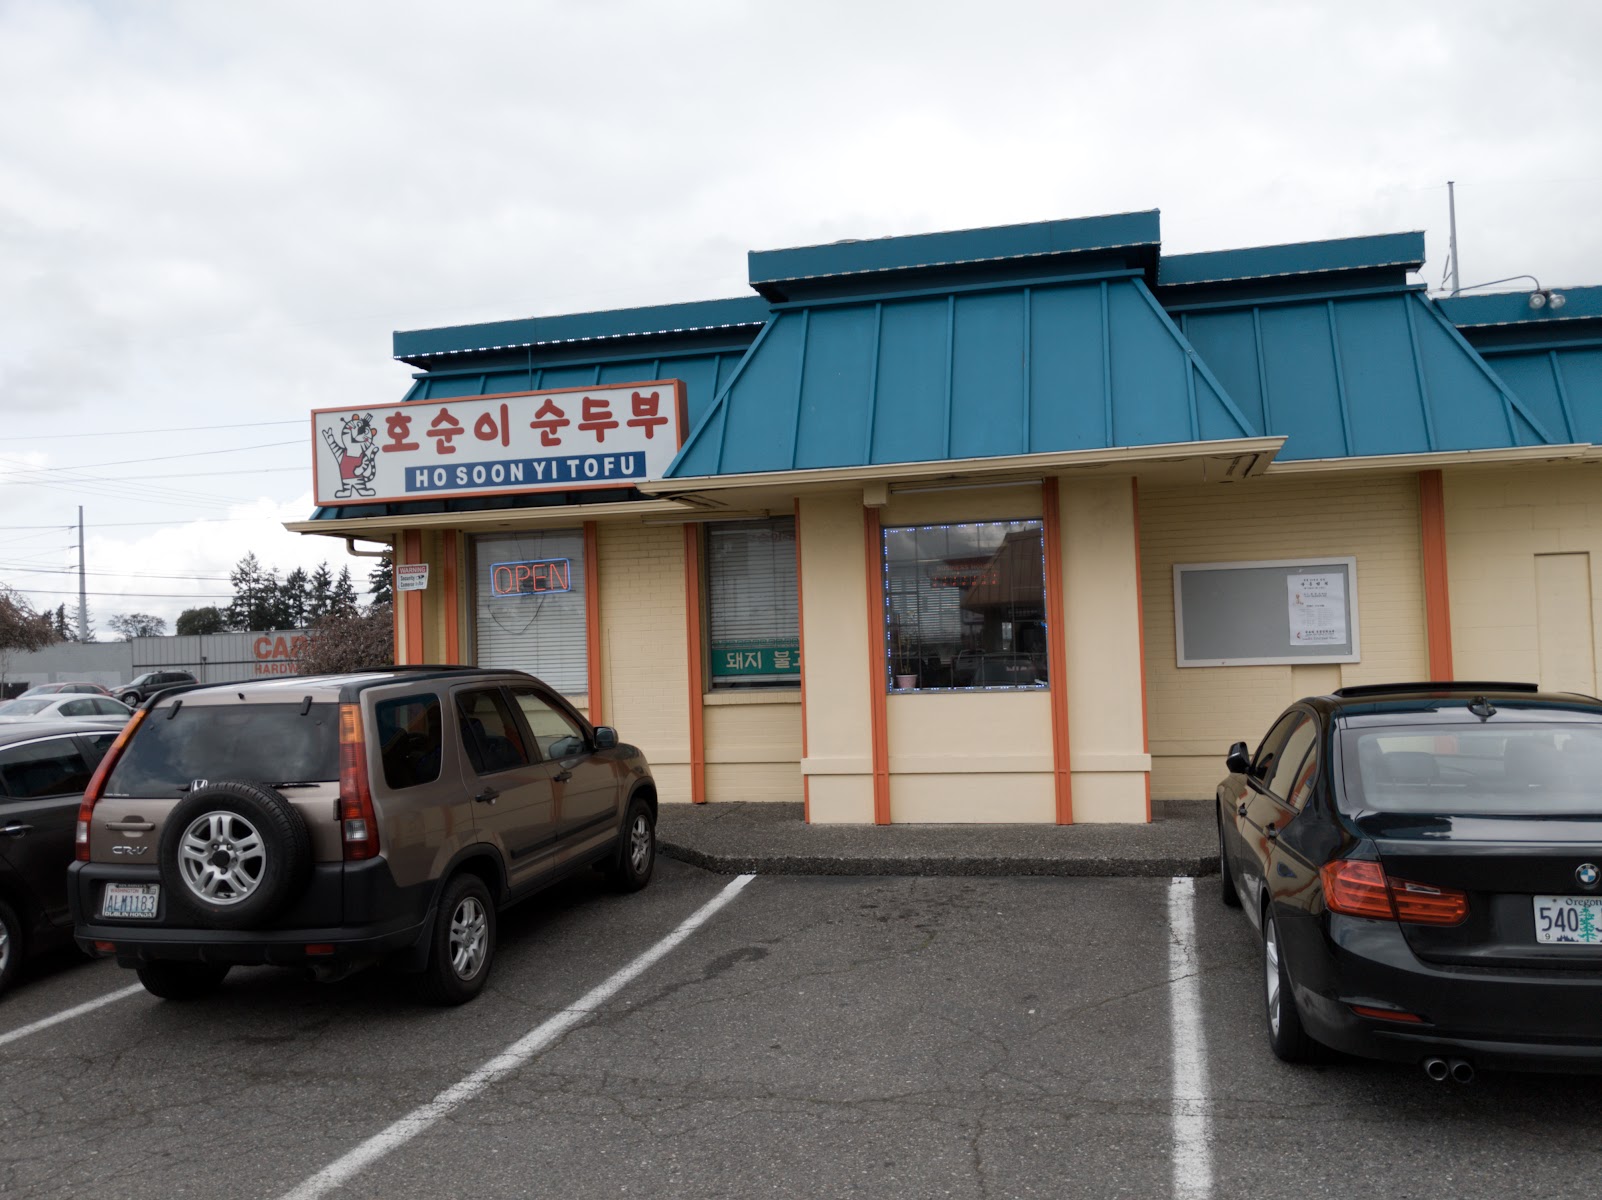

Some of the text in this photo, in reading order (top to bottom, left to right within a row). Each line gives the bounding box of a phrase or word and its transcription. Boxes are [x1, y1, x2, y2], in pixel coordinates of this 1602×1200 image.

[382, 391, 668, 455] 호순이 순두부
[415, 455, 634, 488] HO SOON YI TOFU
[400, 566, 426, 574] WARNING
[494, 563, 567, 594] OPEN
[255, 663, 298, 675] HARDW
[726, 651, 762, 670] 돼지
[112, 845, 148, 855] CR-V
[106, 895, 155, 912] ALM1183
[1565, 898, 1602, 908] Oregon
[1540, 907, 1579, 932] 540
